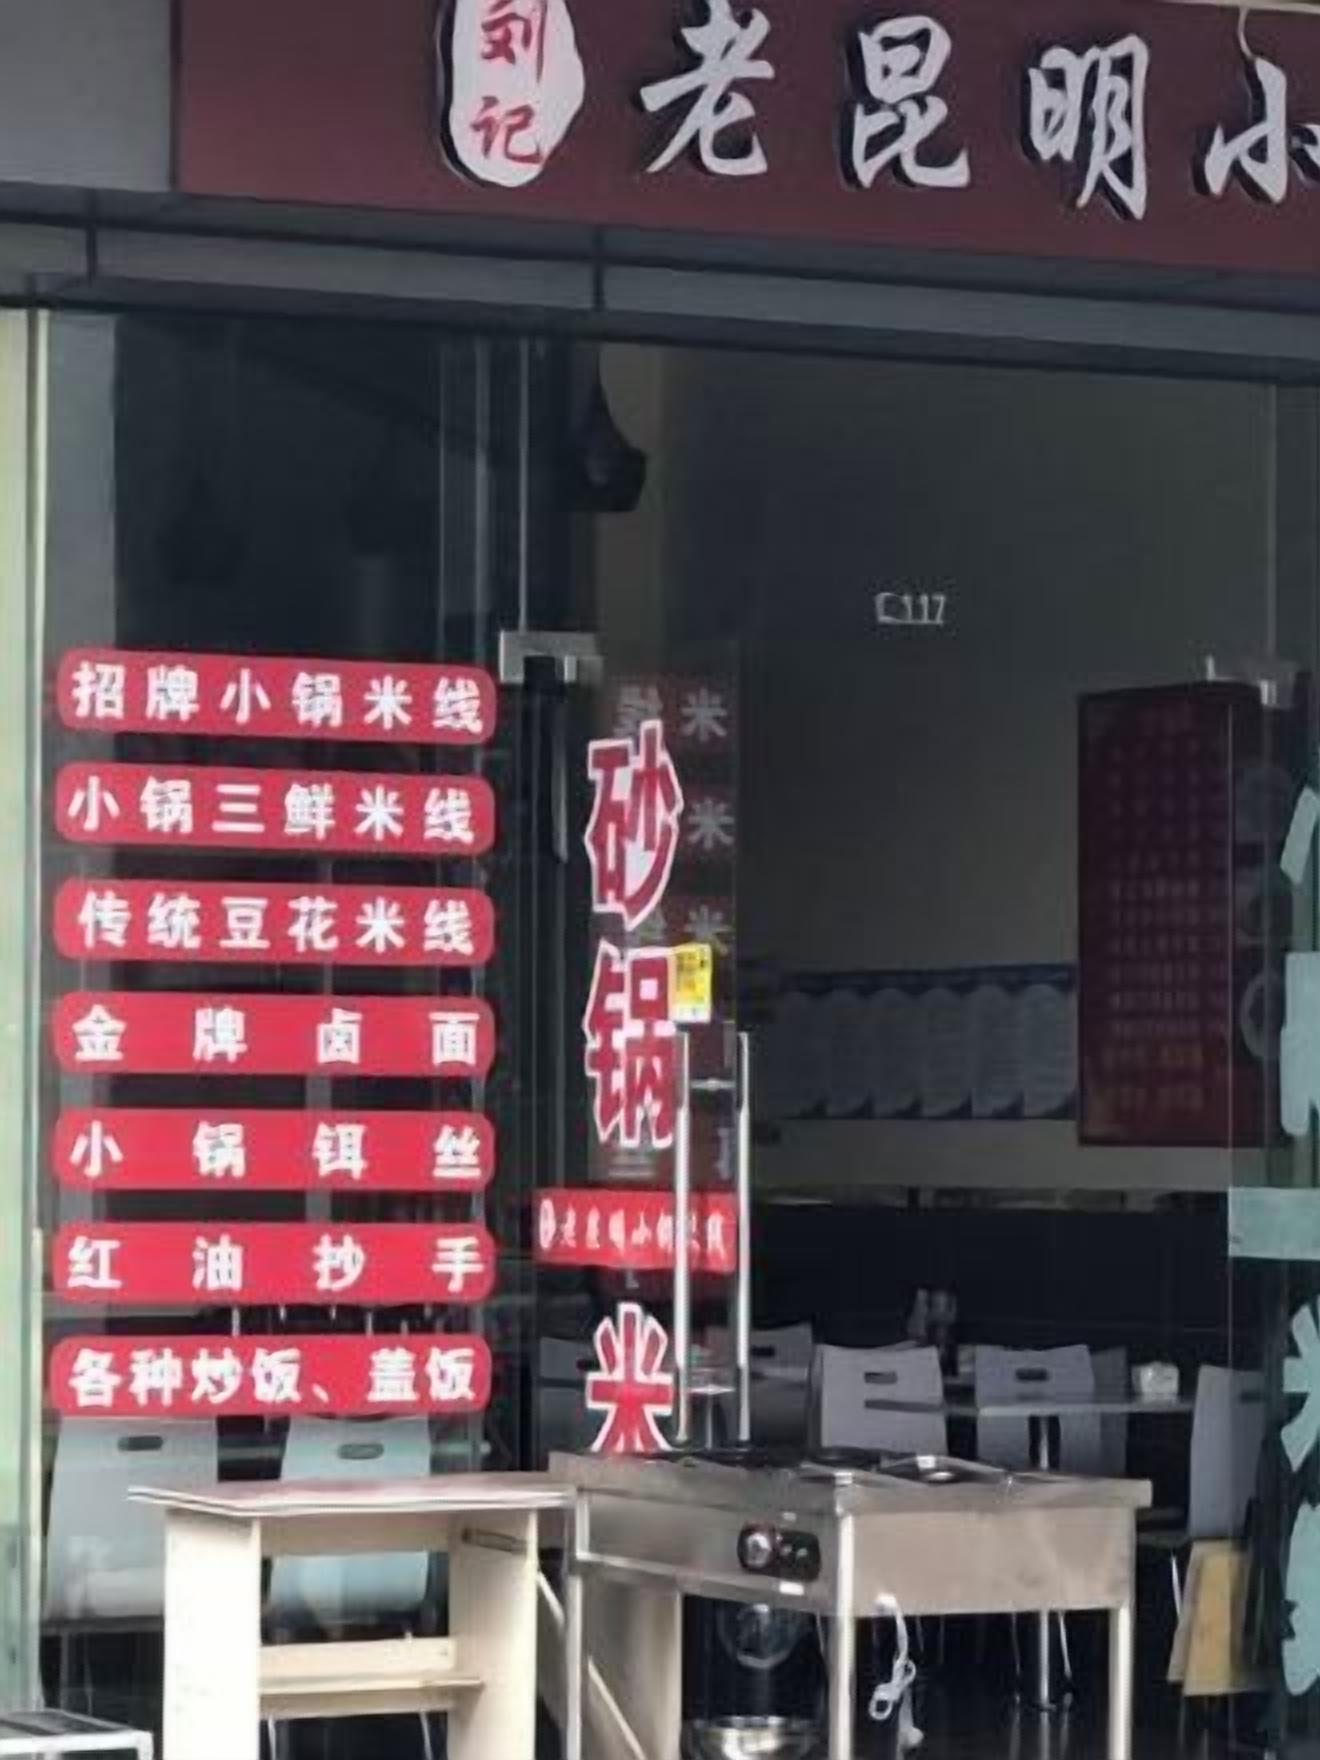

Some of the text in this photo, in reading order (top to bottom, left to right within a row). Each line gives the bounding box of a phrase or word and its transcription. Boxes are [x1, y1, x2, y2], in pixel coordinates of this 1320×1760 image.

[470, 0, 544, 164] 刘记
[71, 660, 484, 735] 招牌小锅米线
[67, 775, 476, 845] 小锅三鲜米线
[77, 889, 475, 956] 传统豆花米线
[71, 1003, 482, 1066] 金牌卤面
[67, 1233, 485, 1293] 红油抄手
[69, 1346, 476, 1408] 各种炒饭、盖饭
